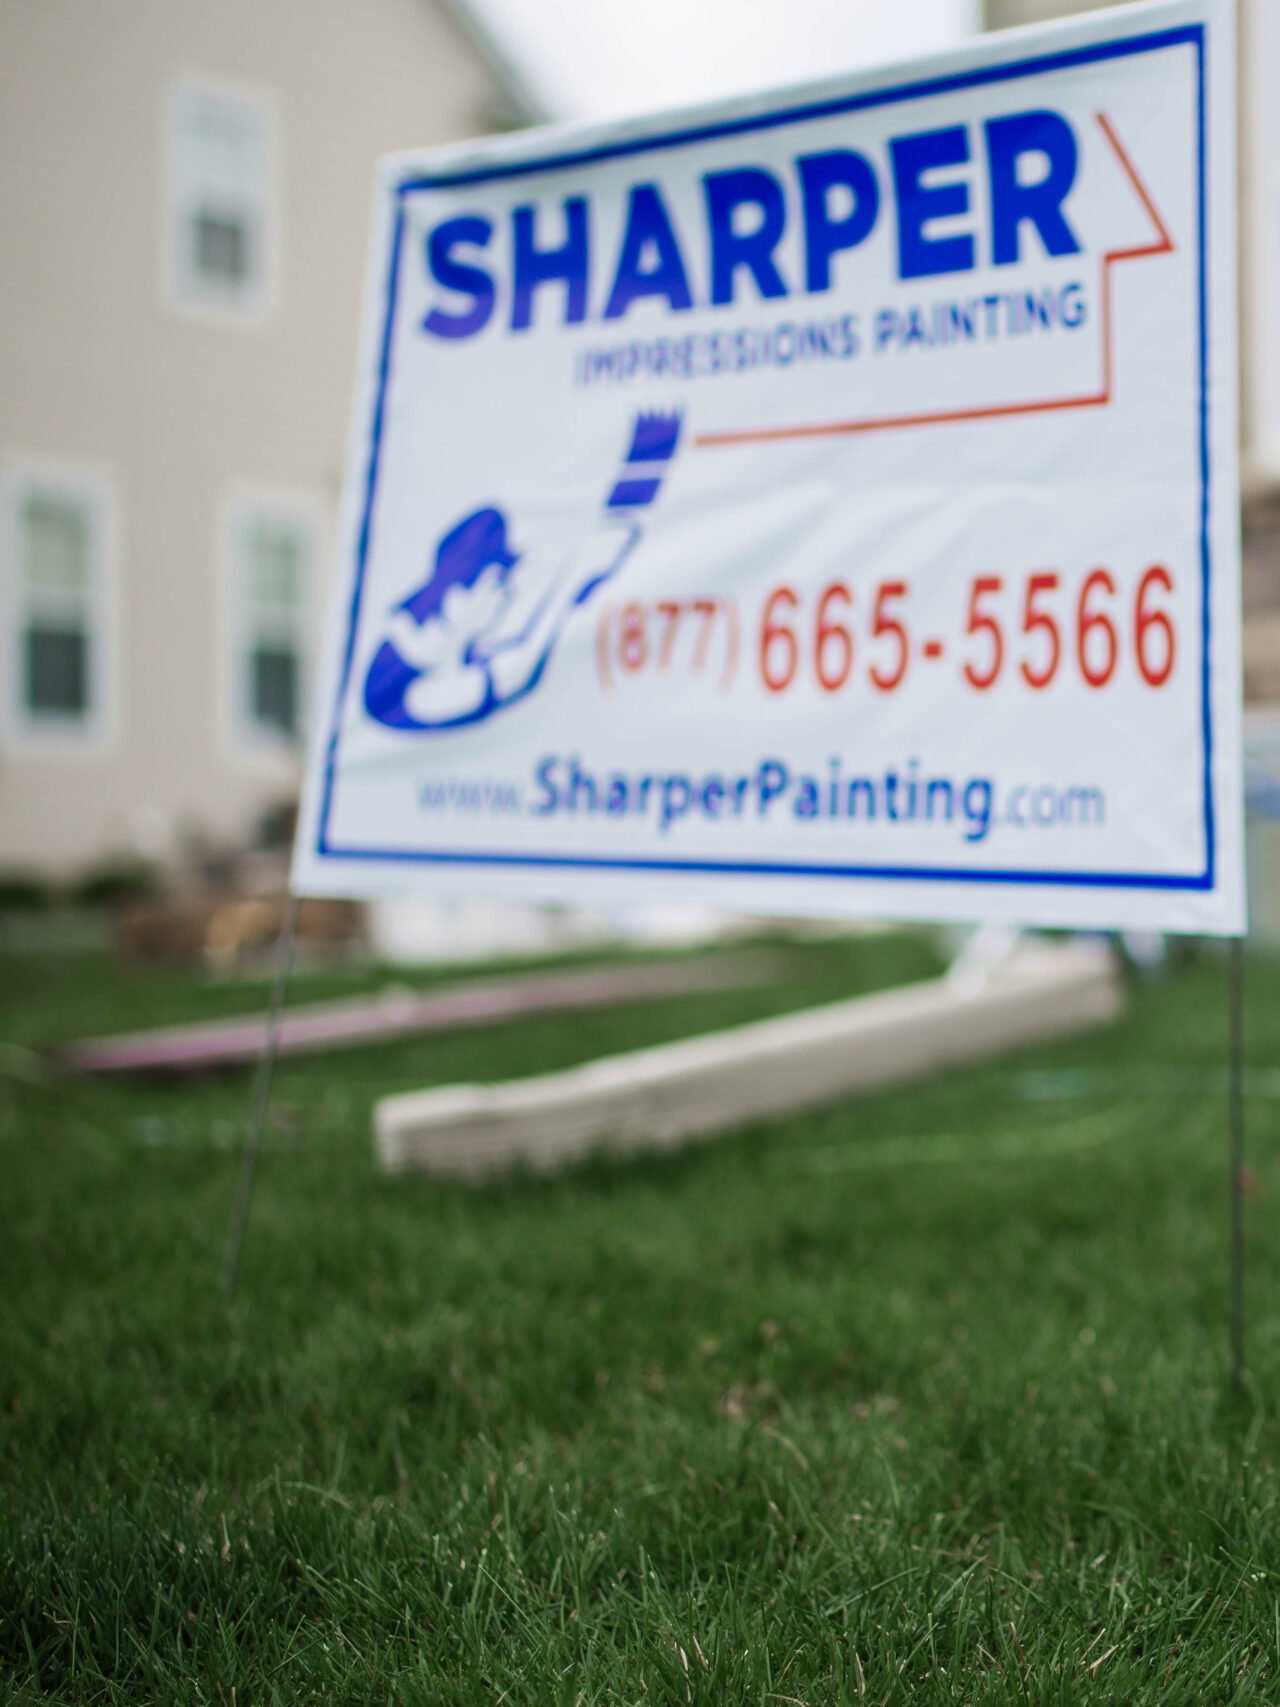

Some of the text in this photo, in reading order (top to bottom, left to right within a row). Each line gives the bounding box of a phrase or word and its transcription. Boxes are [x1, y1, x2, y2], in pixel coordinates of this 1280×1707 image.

[420, 108, 1083, 348] SHARPER
[576, 283, 1088, 387] IMPRESSIONS PAINTING
[599, 564, 1177, 698] (877) 665-5566
[418, 757, 1106, 840] www.SharperPainting.com
